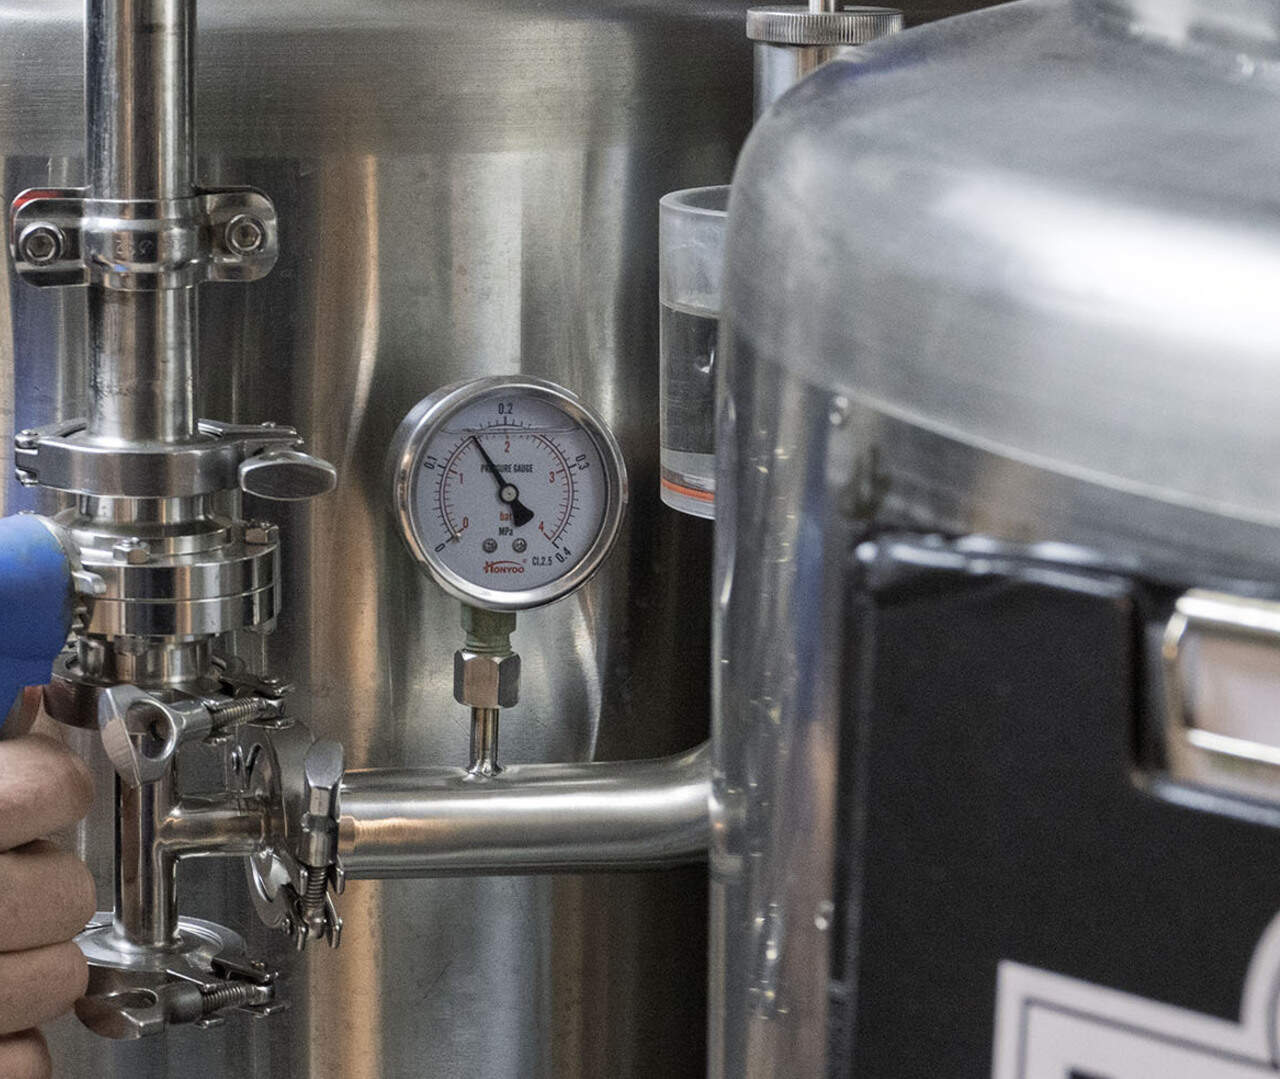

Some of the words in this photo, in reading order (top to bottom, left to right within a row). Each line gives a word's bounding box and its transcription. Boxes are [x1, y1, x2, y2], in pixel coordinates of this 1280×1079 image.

[497, 402, 513, 415] 0.2
[504, 441, 510, 453] 2
[423, 455, 438, 471] 0.1
[575, 453, 591, 471] 0.3
[548, 471, 555, 484] 3
[462, 516, 469, 529] 0
[538, 520, 545, 533] 4
[498, 526, 514, 537] MPa
[554, 546, 572, 564] 0.4
